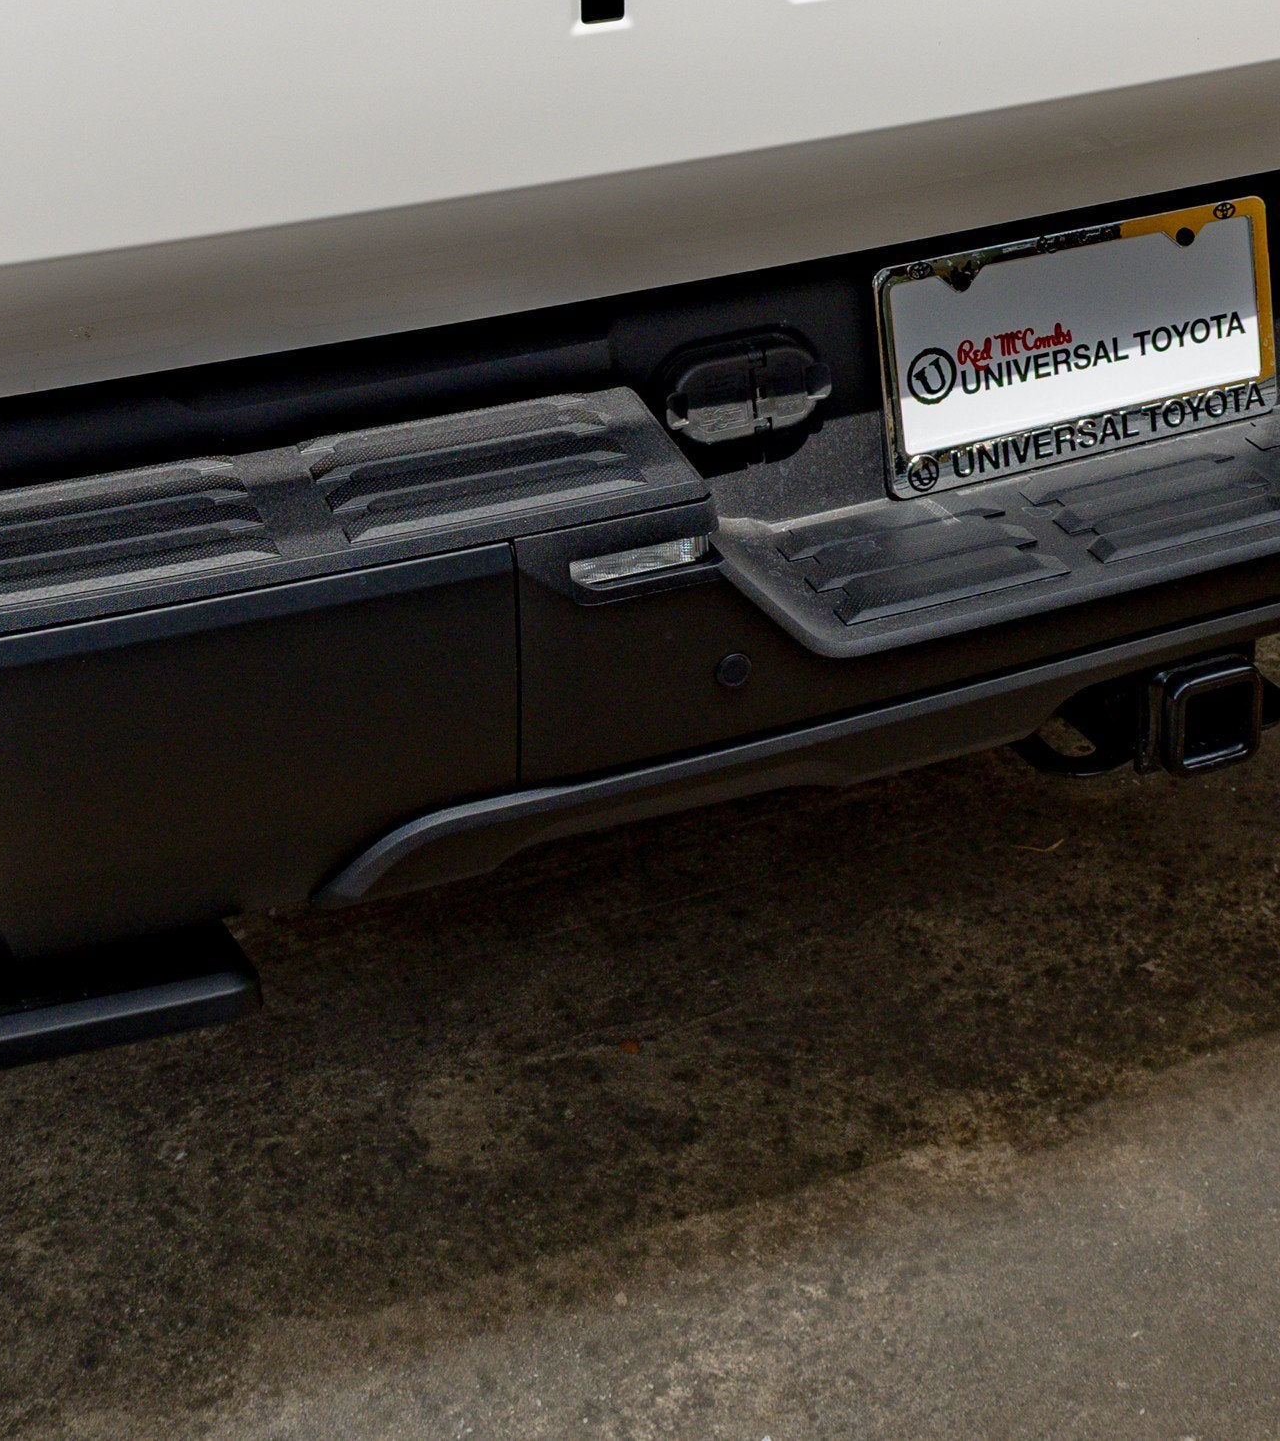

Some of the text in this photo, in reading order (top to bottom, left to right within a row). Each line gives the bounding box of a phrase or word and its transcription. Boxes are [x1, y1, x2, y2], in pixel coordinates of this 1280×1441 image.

[957, 322, 1073, 371] Red McCombs
[960, 311, 1247, 395] UNIVERSAL TOYOTA
[950, 381, 1267, 478] UNIVERSAL TOYOTA
